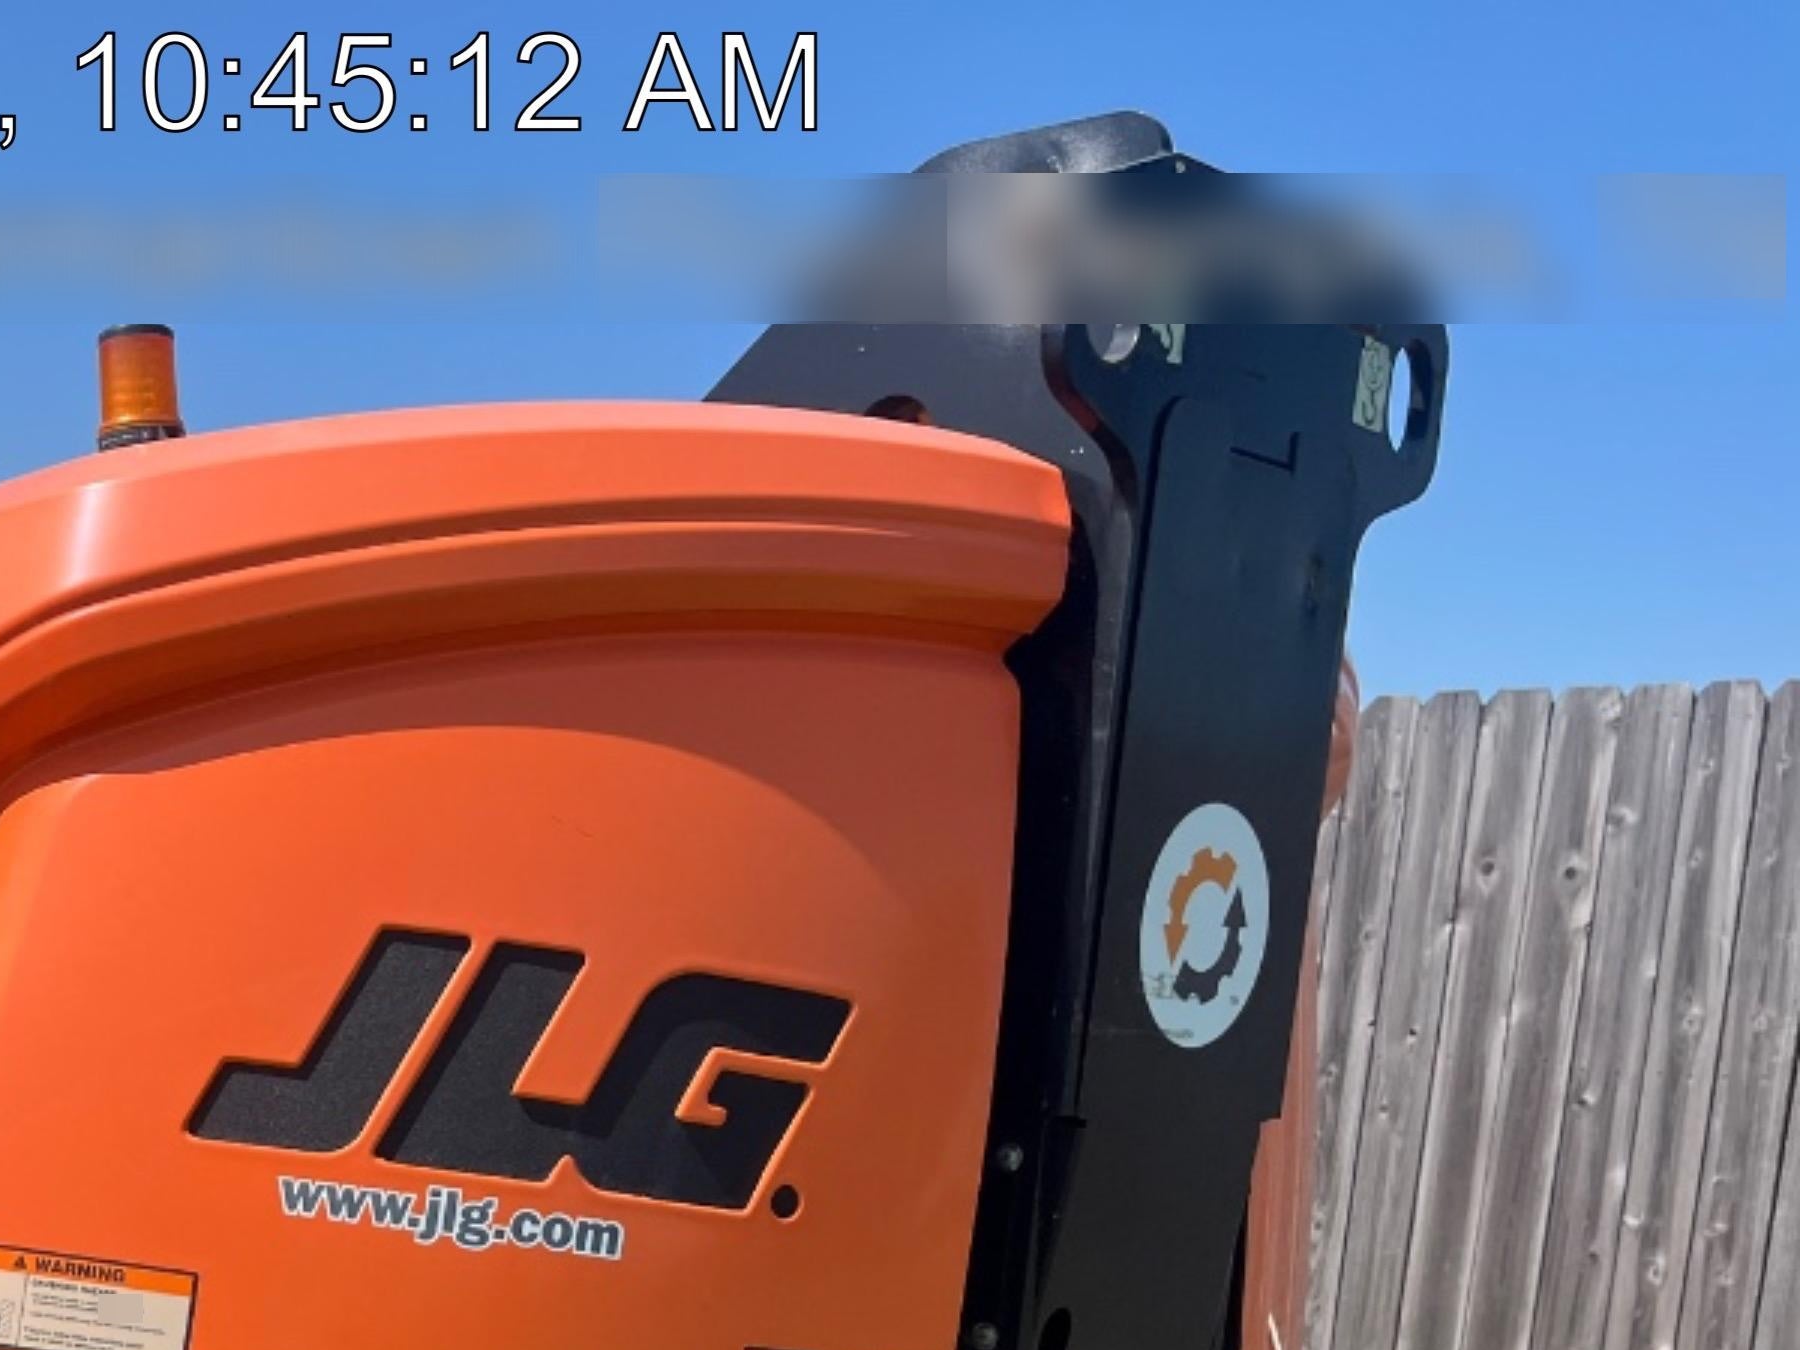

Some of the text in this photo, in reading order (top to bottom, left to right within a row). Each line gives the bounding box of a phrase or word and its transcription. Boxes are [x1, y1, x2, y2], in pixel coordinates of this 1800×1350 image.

[186, 924, 855, 1212] JLG
[278, 1175, 625, 1261] www.jlg.com
[34, 1256, 126, 1283] WARNING
